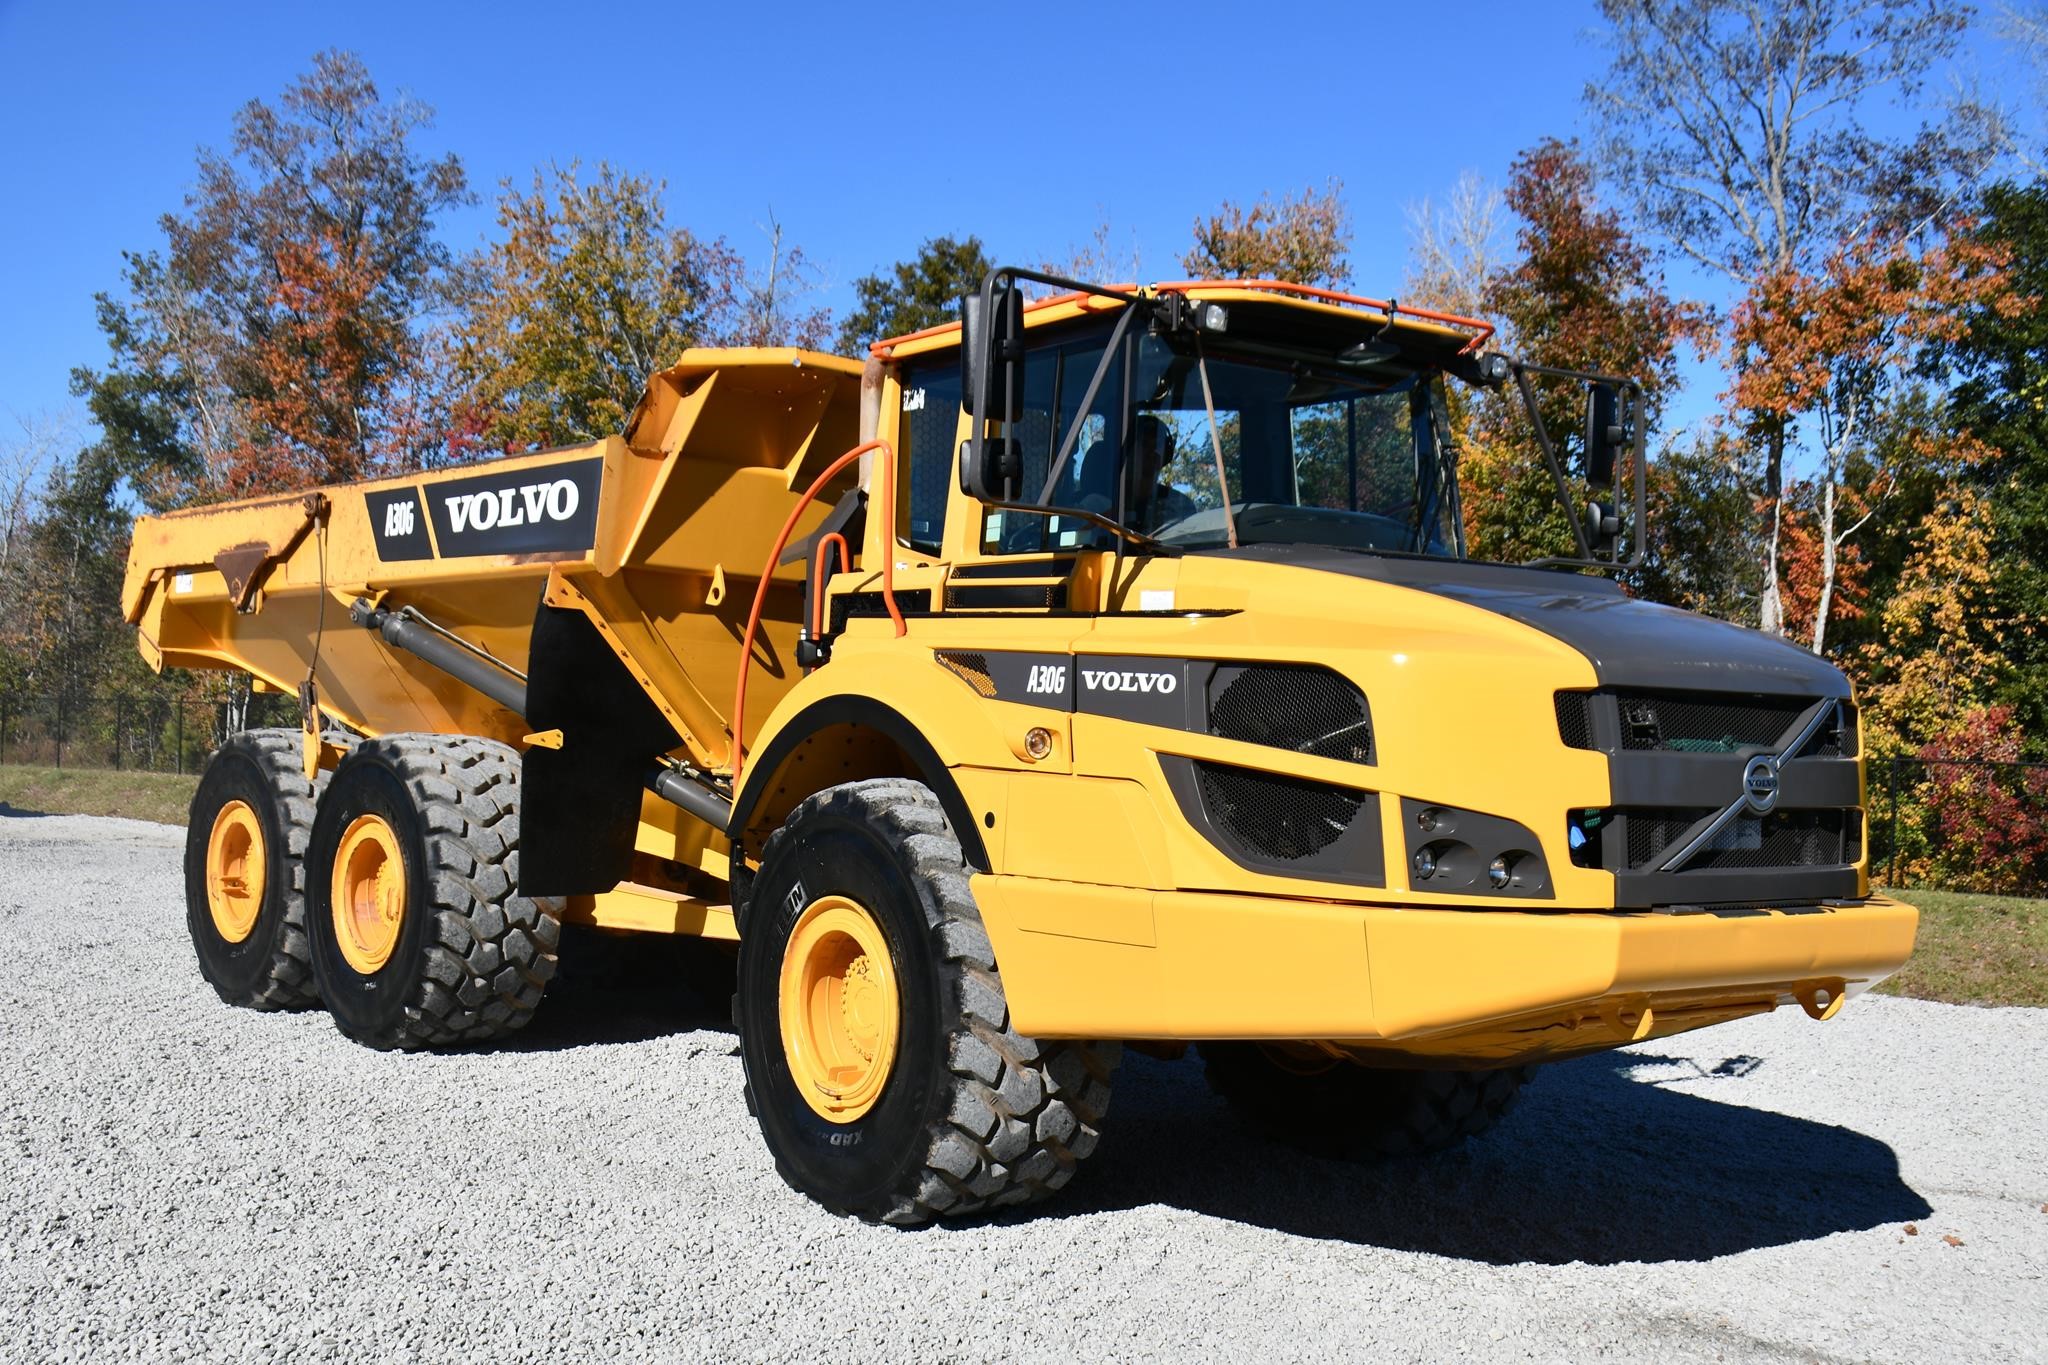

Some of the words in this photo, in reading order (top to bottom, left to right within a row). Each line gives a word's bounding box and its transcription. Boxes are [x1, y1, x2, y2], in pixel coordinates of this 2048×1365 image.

[445, 479, 579, 533] VOLVO
[1026, 665, 1066, 694] A30G
[1081, 670, 1177, 694] VOLVO
[1747, 779, 1778, 788] VOLVO
